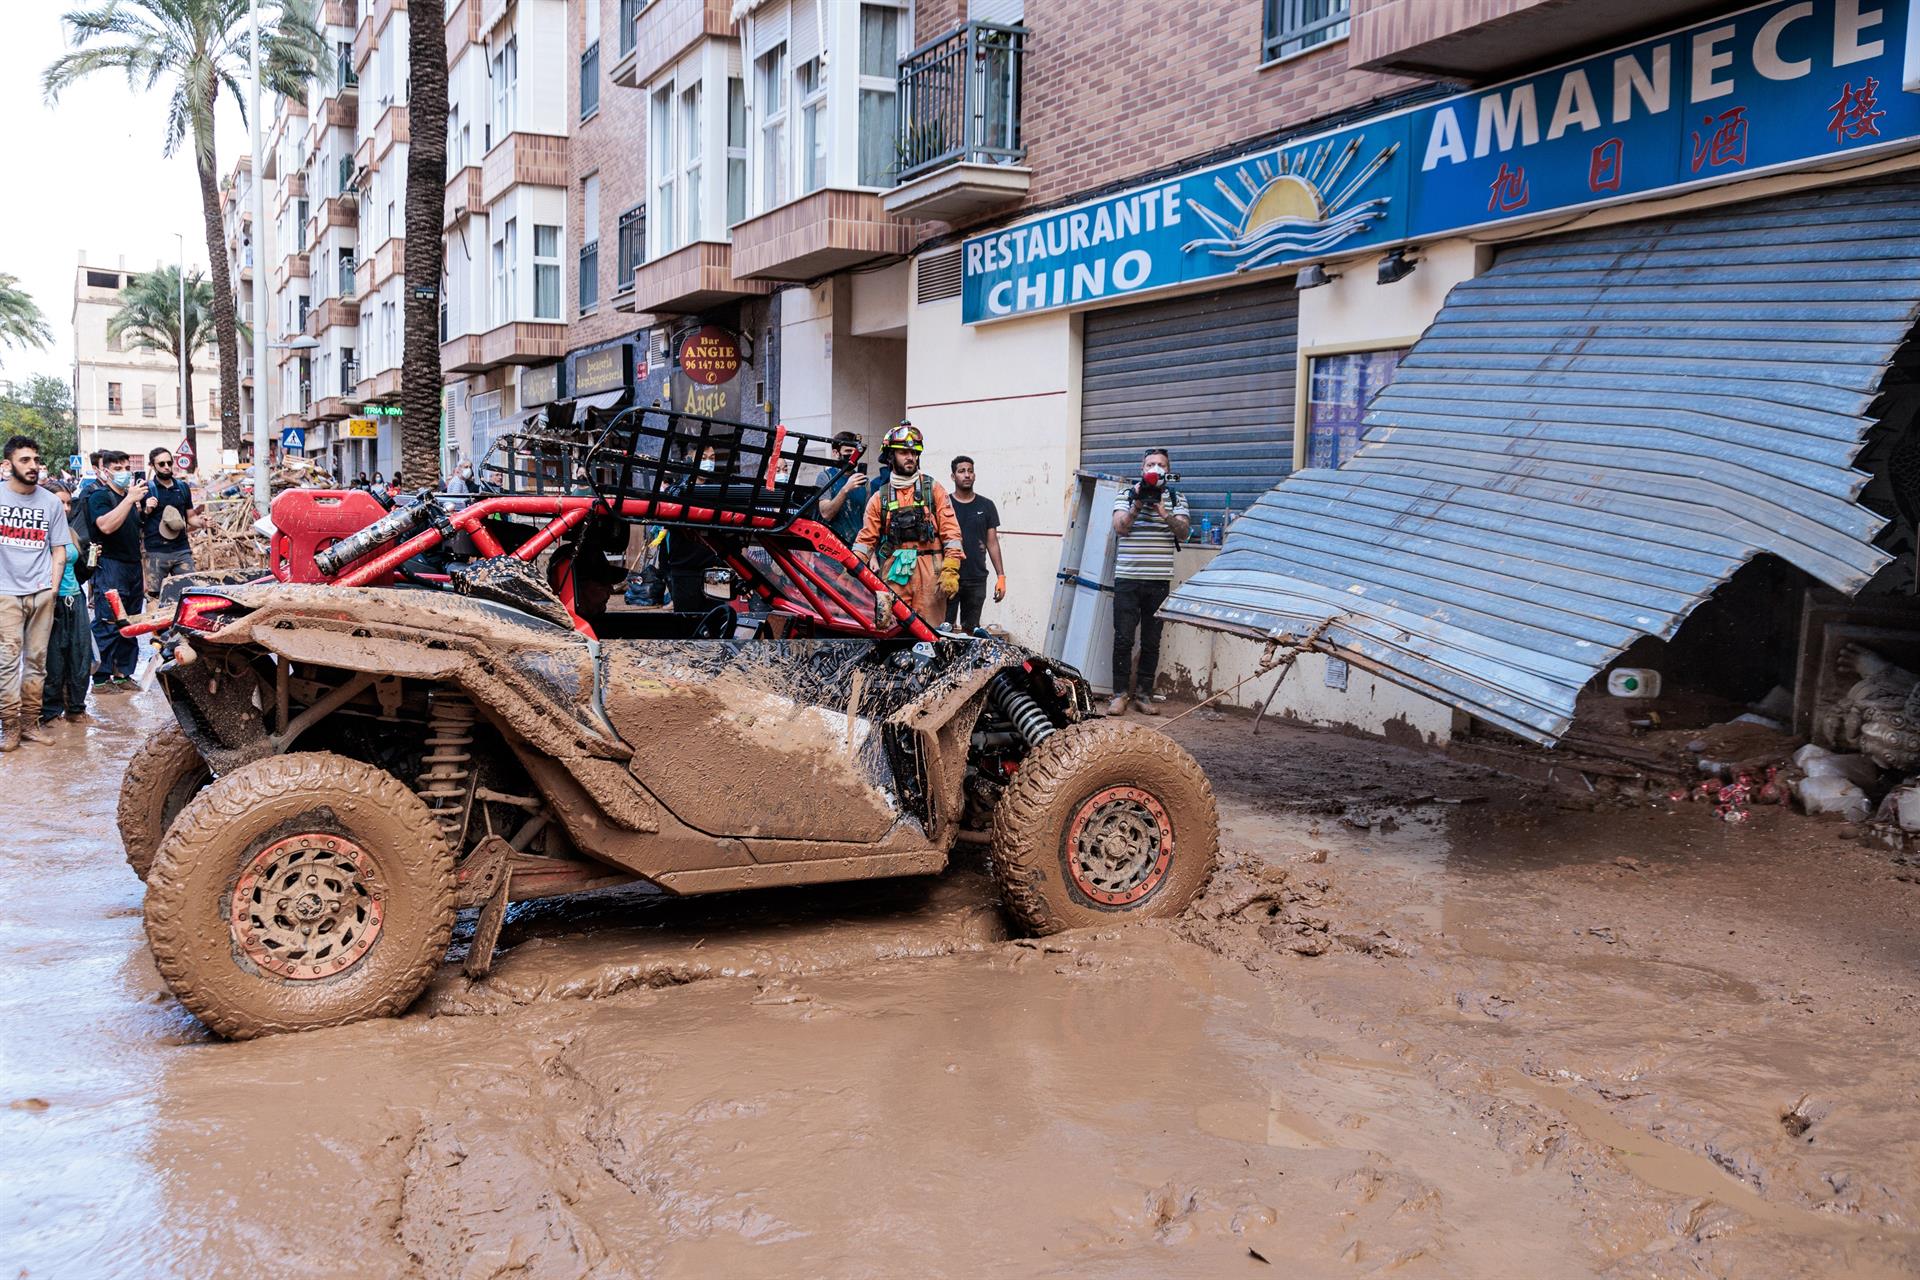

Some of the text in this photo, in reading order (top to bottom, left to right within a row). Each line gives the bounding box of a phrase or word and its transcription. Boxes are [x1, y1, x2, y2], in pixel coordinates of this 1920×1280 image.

[1421, 0, 1884, 172] AMANECE
[968, 184, 1181, 276] RESTAURANTE
[988, 250, 1152, 314] CHINO
[685, 346, 734, 358] ANGIE
[701, 337, 719, 345] Bar
[686, 360, 737, 370] 96 147 82 09
[684, 384, 727, 417] Angie
[0, 505, 44, 521] BARE
